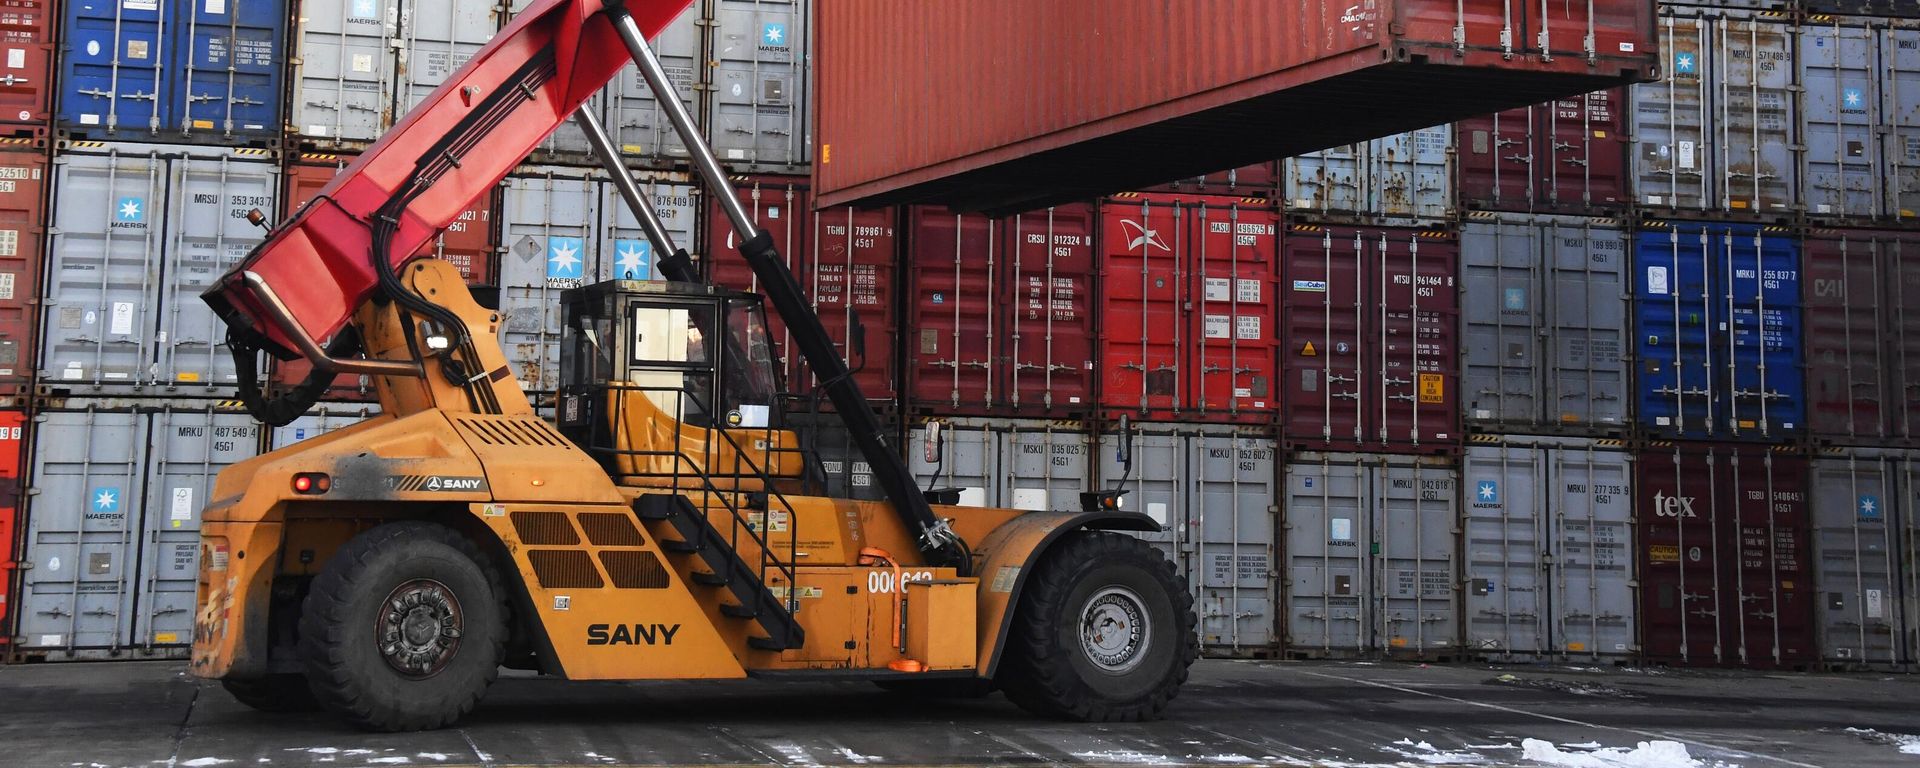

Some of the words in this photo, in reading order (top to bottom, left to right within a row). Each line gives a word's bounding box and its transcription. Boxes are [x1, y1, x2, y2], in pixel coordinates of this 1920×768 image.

[347, 18, 382, 26] MAERSK
[1898, 40, 1917, 50] MRKU
[1733, 50, 1751, 59] MRKU
[1759, 51, 1770, 60] 571
[1759, 62, 1775, 71] 45G1
[194, 194, 218, 205] MRSU
[231, 195, 247, 206] 353
[249, 196, 265, 207] 343
[266, 197, 272, 207] 7
[657, 196, 671, 206] 876
[673, 197, 687, 207] 409
[689, 198, 694, 207] 0
[826, 225, 846, 235] TGHU
[855, 226, 883, 237] 789861
[1211, 223, 1230, 233] HASU
[1237, 224, 1265, 234] 496625
[854, 238, 874, 249] 45G1
[1027, 234, 1046, 244] CRSU
[1054, 235, 1080, 246] 912324
[1237, 236, 1256, 245] 45G1
[1564, 239, 1583, 248] MSKU
[1592, 240, 1604, 250] 189
[1605, 241, 1618, 250] 990
[1054, 247, 1071, 257] 45G1
[1592, 254, 1607, 263] 45G1
[1735, 269, 1755, 279] MRKU
[1763, 270, 1776, 279] 255
[1777, 271, 1789, 280] 837
[1791, 271, 1796, 281] 7
[1393, 275, 1410, 285] MTSU
[1417, 276, 1441, 286] 961464
[1448, 277, 1453, 287] 8
[1763, 280, 1780, 289] 45G1
[1417, 287, 1433, 297] 45G1
[1814, 278, 1844, 298] CAI
[178, 426, 203, 437] MRKU
[214, 427, 230, 438] 487
[232, 427, 248, 438] 549
[249, 428, 255, 438] 4
[214, 441, 234, 452] 45G1
[1023, 444, 1043, 454] MSKU
[1051, 445, 1065, 455] 035
[1066, 445, 1079, 455] 025
[1209, 449, 1230, 459] MSKU
[1239, 450, 1252, 460] 052
[1253, 451, 1266, 460] 602
[1267, 451, 1272, 460] 7
[1051, 456, 1069, 466] 45G1
[1239, 462, 1256, 471] 45G1
[443, 479, 481, 489] SANY
[852, 475, 870, 485] 45G1
[1392, 479, 1412, 489] MRKU
[1421, 480, 1434, 490] 042
[1421, 490, 1438, 500] 42G1
[1567, 484, 1586, 494] MRKU
[1594, 485, 1607, 494] 277
[1608, 485, 1621, 495] 335
[1624, 487, 1629, 496] 9
[1595, 495, 1611, 504] 45G1
[1653, 488, 1697, 518] tex
[1650, 545, 1680, 553] CAUTION
[587, 623, 681, 645] SANY
